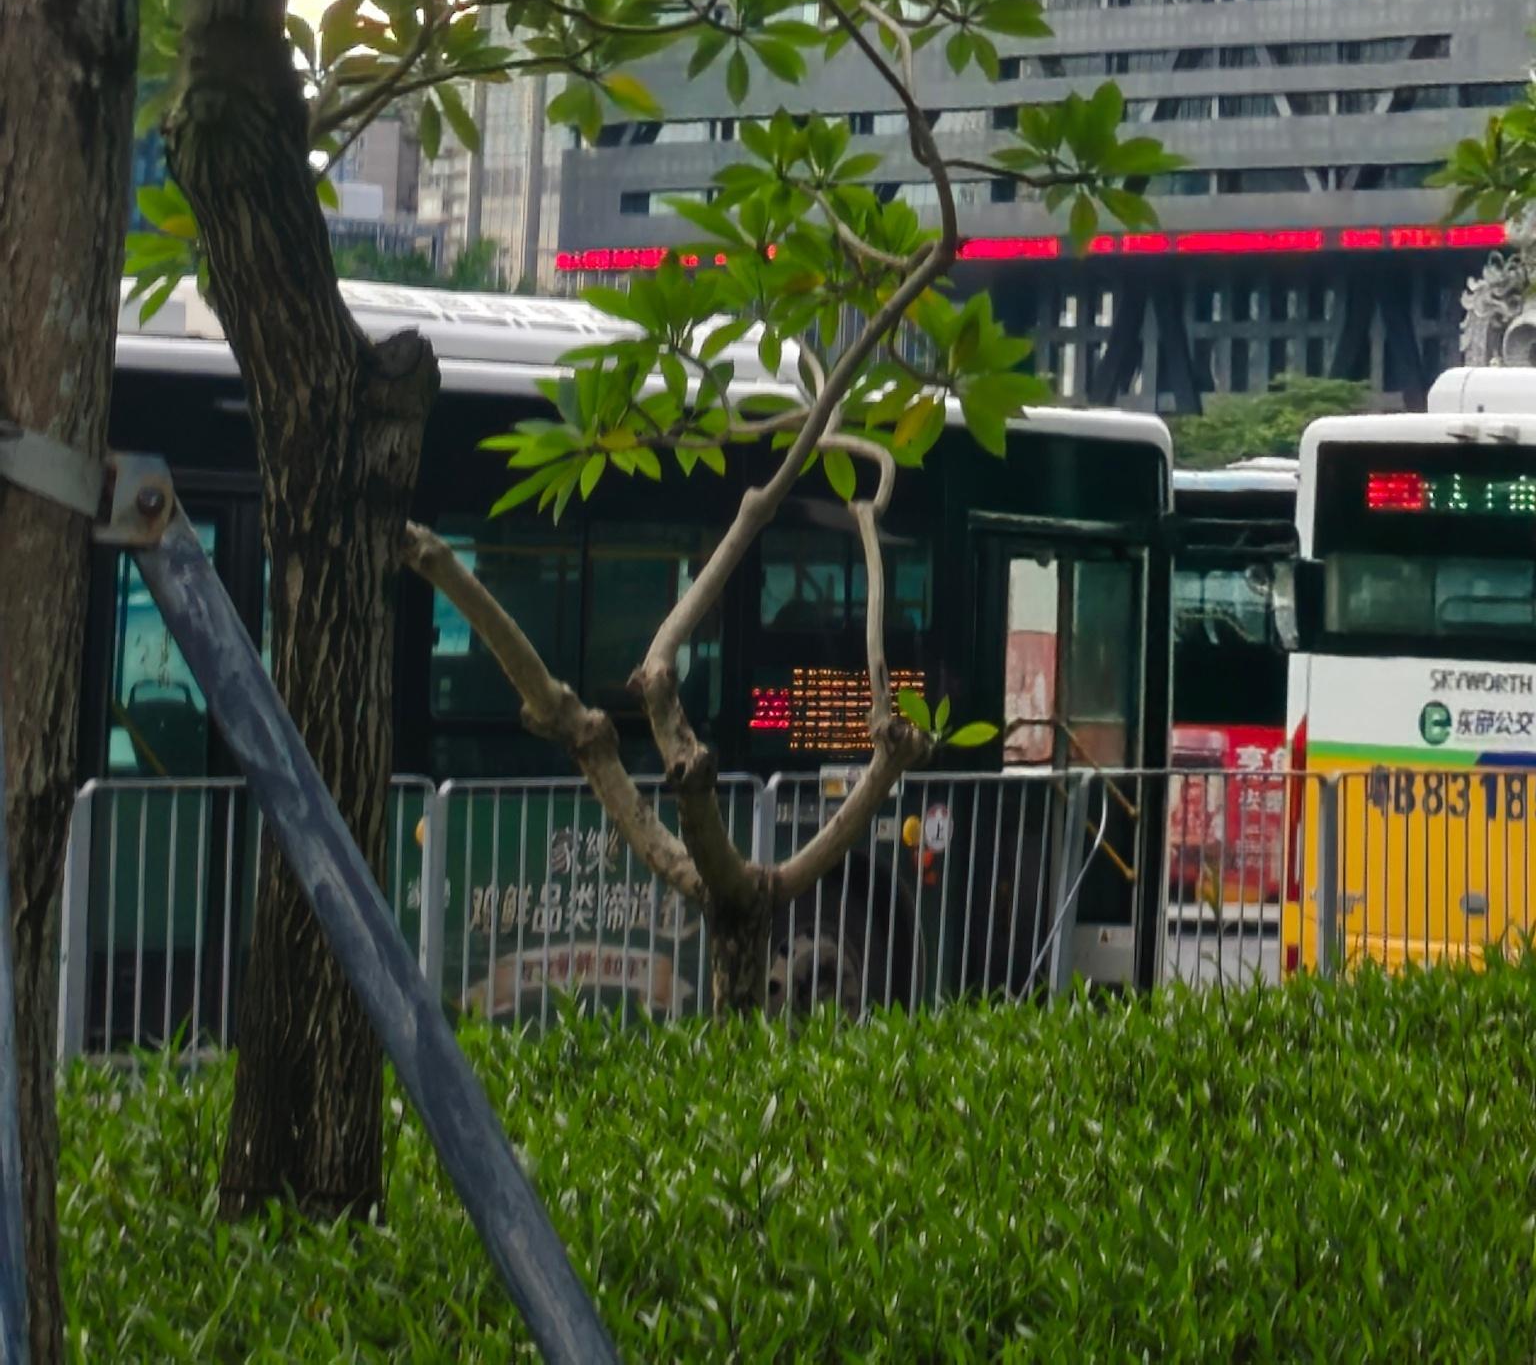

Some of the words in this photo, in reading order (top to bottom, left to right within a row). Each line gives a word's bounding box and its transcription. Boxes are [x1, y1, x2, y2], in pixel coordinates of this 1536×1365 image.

[1430, 668, 1533, 693] SKYWORTH
[1457, 709, 1535, 735] 东部公交
